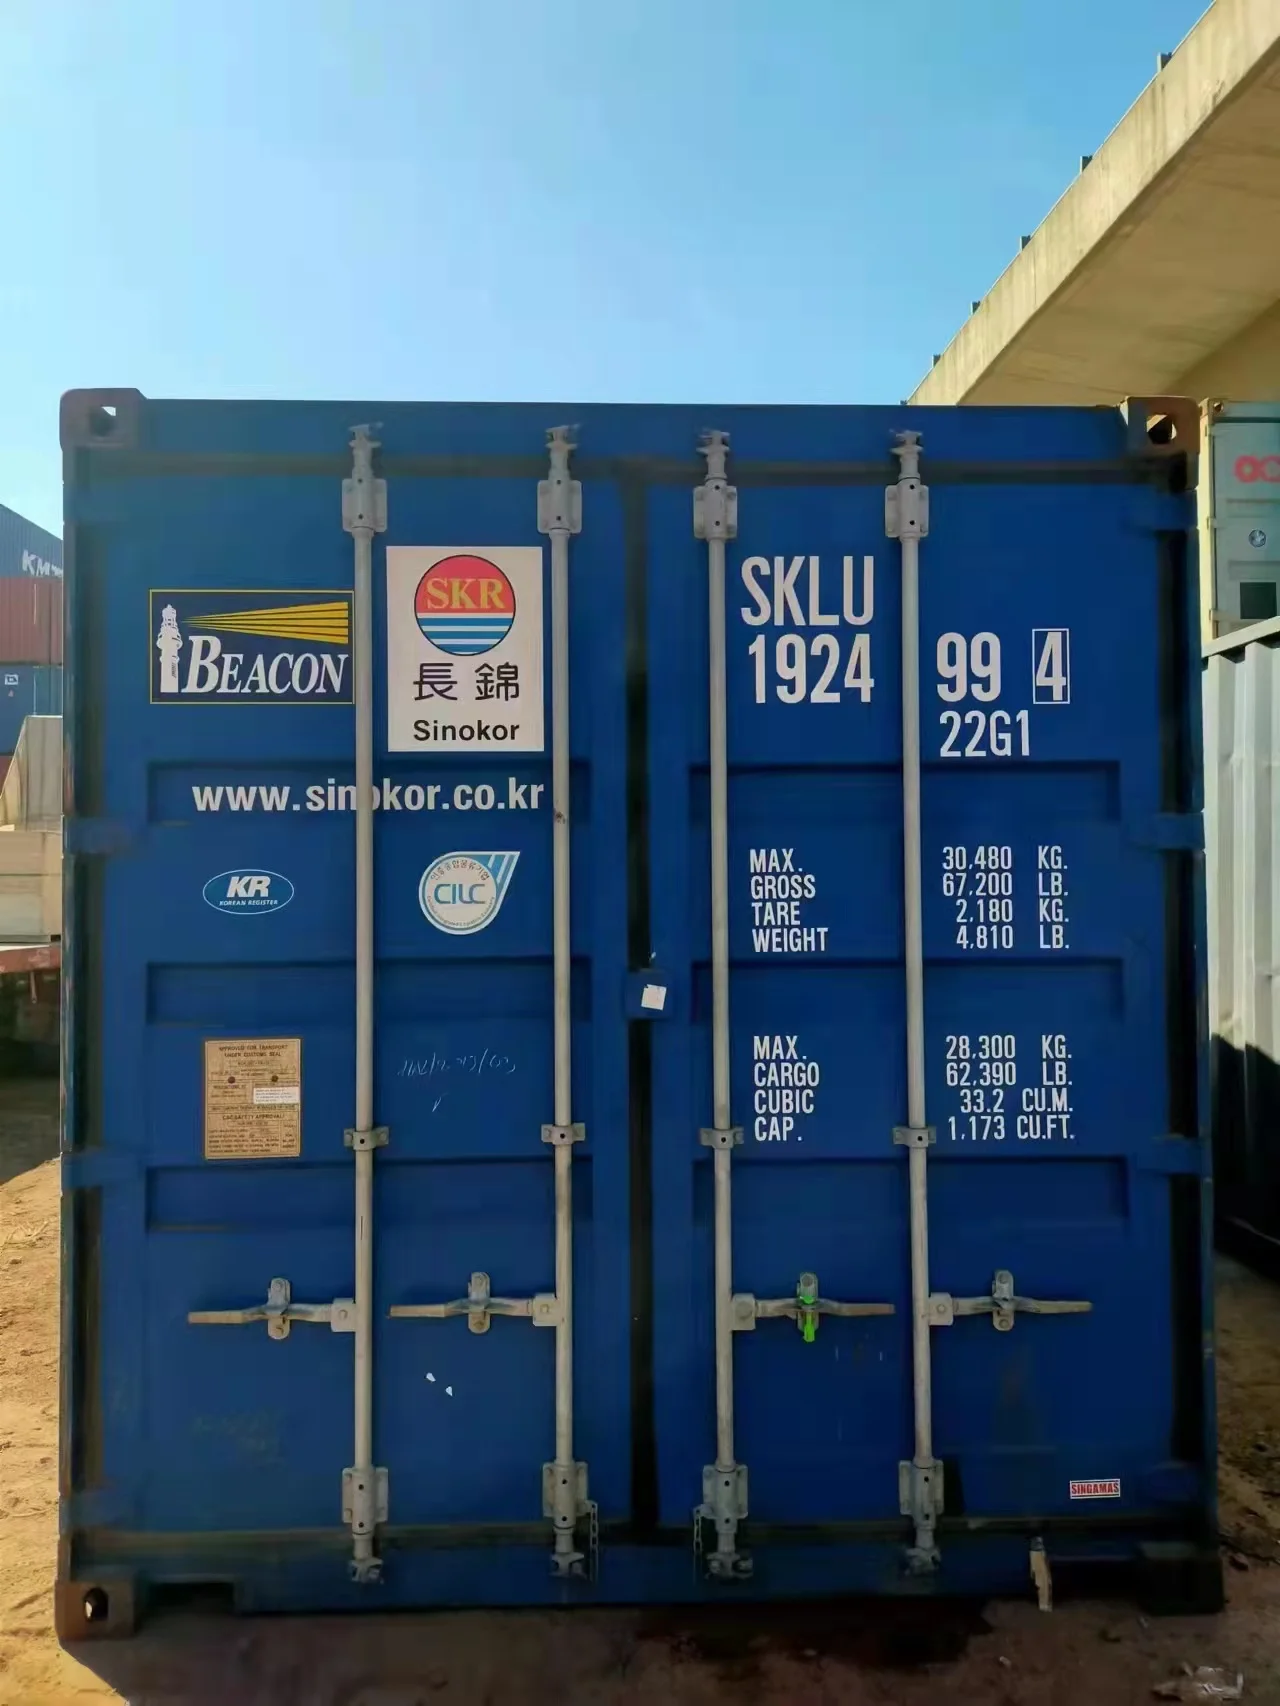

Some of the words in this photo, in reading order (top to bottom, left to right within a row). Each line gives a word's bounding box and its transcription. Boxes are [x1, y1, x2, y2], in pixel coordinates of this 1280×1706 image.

[426, 577, 505, 609] SKR
[741, 555, 875, 626] SKLU
[749, 633, 875, 704] 1924
[937, 631, 1001, 702] 99
[1036, 631, 1067, 701] 4
[413, 719, 520, 741] Sinokor
[940, 709, 1030, 758] 22G1
[750, 848, 803, 873] MAX.
[942, 845, 1012, 870] 30,480
[1037, 845, 1068, 870] KG.
[226, 875, 271, 898] KR
[434, 883, 486, 905] CILC
[750, 874, 816, 899] GROSS
[942, 872, 1013, 897] 67,200
[1038, 872, 1069, 897] LB.
[751, 901, 801, 926] TARE
[956, 898, 1013, 922] 2,180
[1039, 898, 1070, 922] KG.
[752, 927, 829, 953] WEIGHT
[956, 924, 1014, 949] 4,810
[1039, 924, 1070, 949] LB.
[753, 1035, 807, 1060] MAX.
[946, 1034, 1016, 1059] 28,300
[1041, 1034, 1072, 1059] KG.
[754, 1061, 820, 1087] CARGO
[946, 1061, 1017, 1086] 62,390
[1042, 1061, 1073, 1085] LB.
[754, 1088, 815, 1114] CUBIC
[960, 1088, 1005, 1113] 33.2
[1022, 1087, 1073, 1112] CU.M.
[754, 1116, 803, 1142] CAP.
[948, 1115, 1005, 1140] 1,173
[1017, 1114, 1075, 1140] CU.FT.
[1072, 1482, 1119, 1495] SINGAMAS
